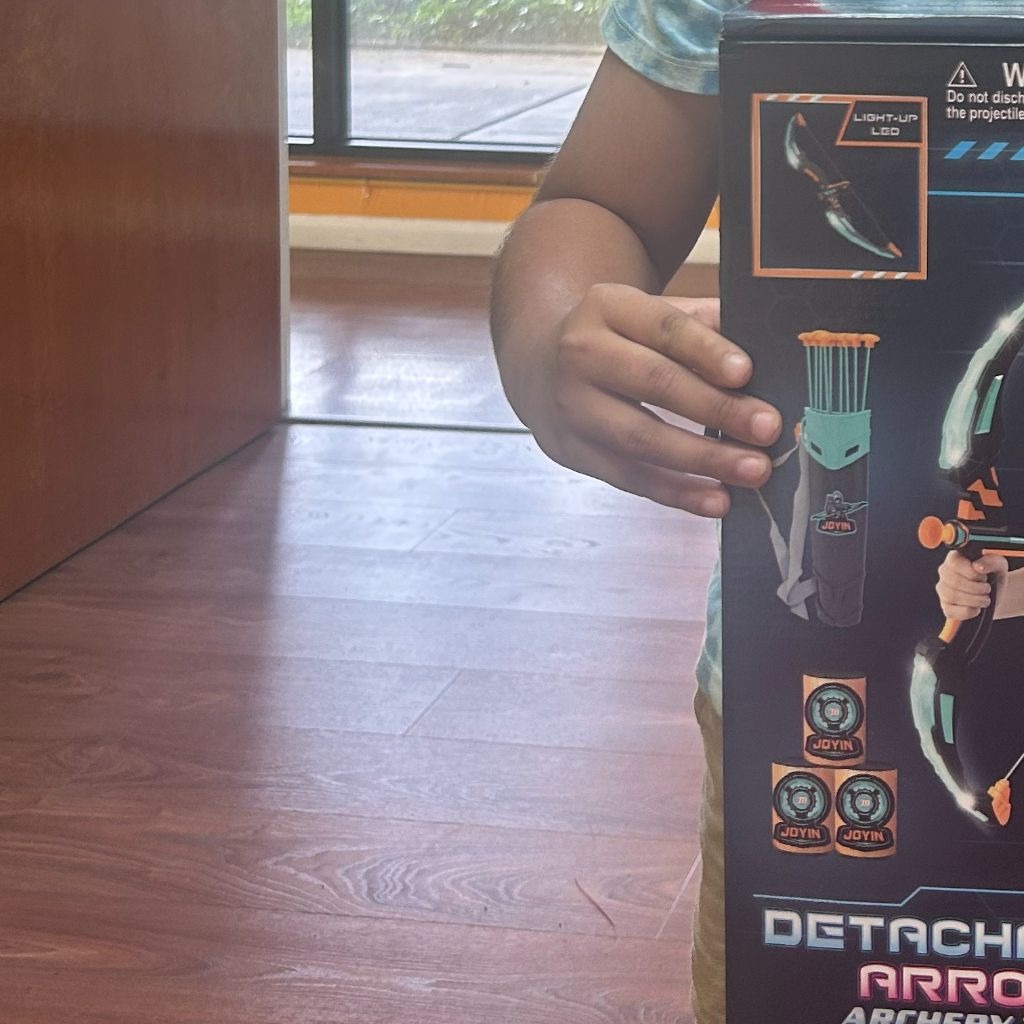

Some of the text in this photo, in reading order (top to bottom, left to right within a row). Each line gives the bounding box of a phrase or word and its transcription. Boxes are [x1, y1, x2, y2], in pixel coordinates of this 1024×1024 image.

[947, 89, 965, 103] Do
[968, 91, 989, 104] not
[854, 113, 919, 123] LIGHT-UP
[947, 107, 967, 120] the
[872, 126, 900, 136] LED
[813, 738, 854, 751] JOYIN
[780, 826, 821, 839] JOYIN
[843, 829, 885, 841] JOYIN
